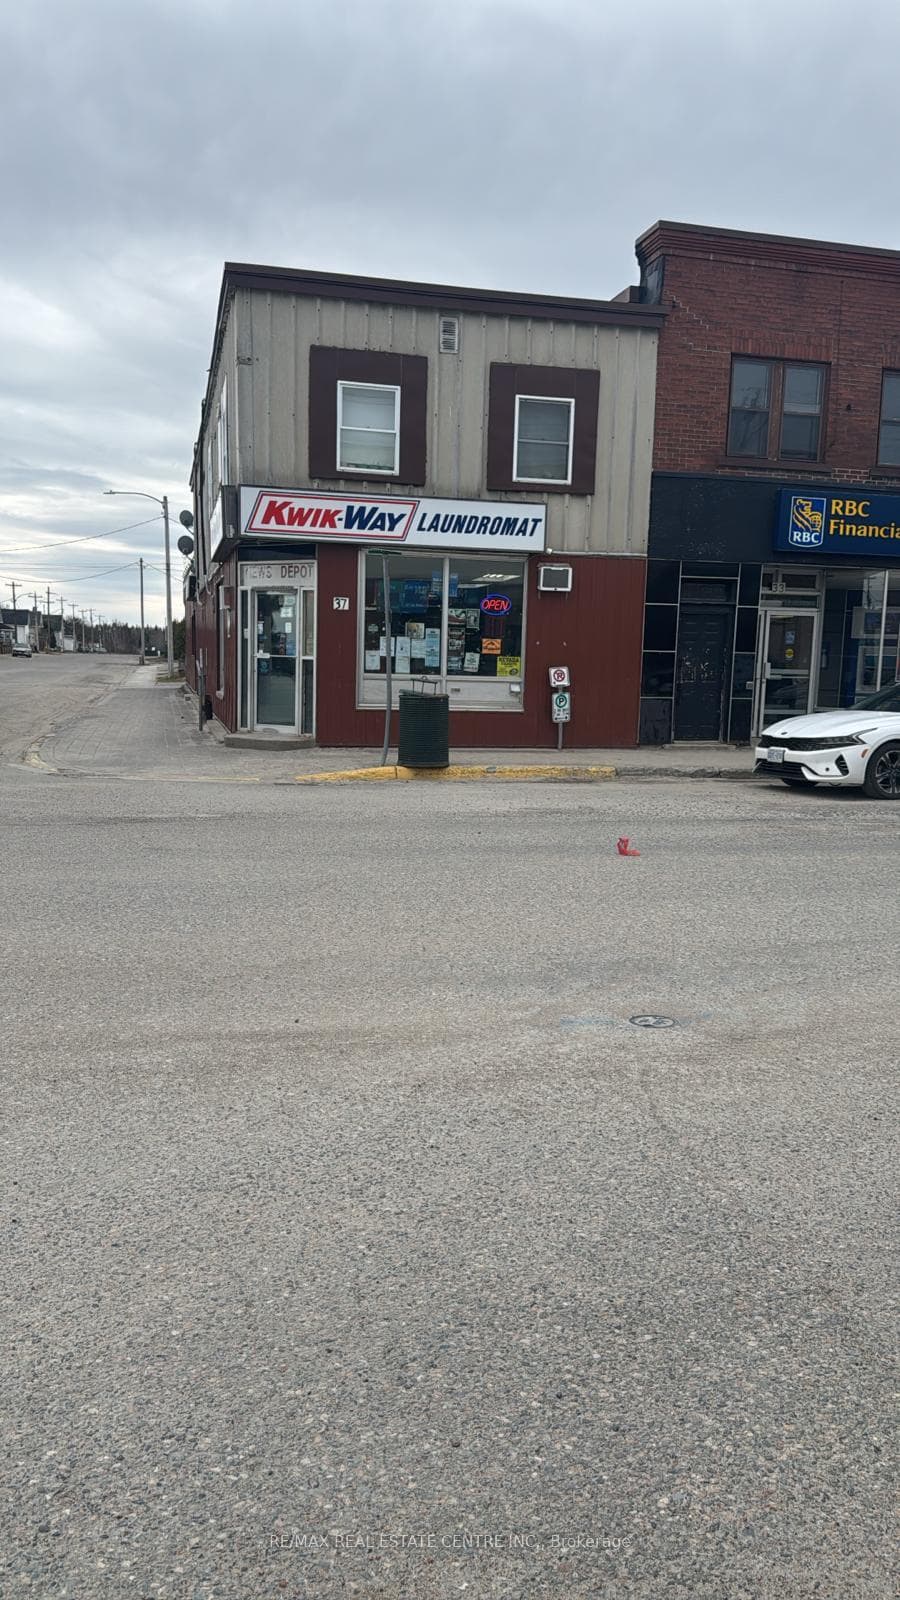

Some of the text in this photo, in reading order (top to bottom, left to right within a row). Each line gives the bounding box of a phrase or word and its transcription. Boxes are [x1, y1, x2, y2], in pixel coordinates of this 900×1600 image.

[831, 499, 871, 517] RBC
[417, 512, 542, 537] LAUNDROMAT
[793, 531, 820, 543] RBC
[280, 564, 314, 579] DEPOT
[772, 583, 785, 593] 33
[335, 598, 347, 609] 37
[482, 600, 509, 611] OPEN
